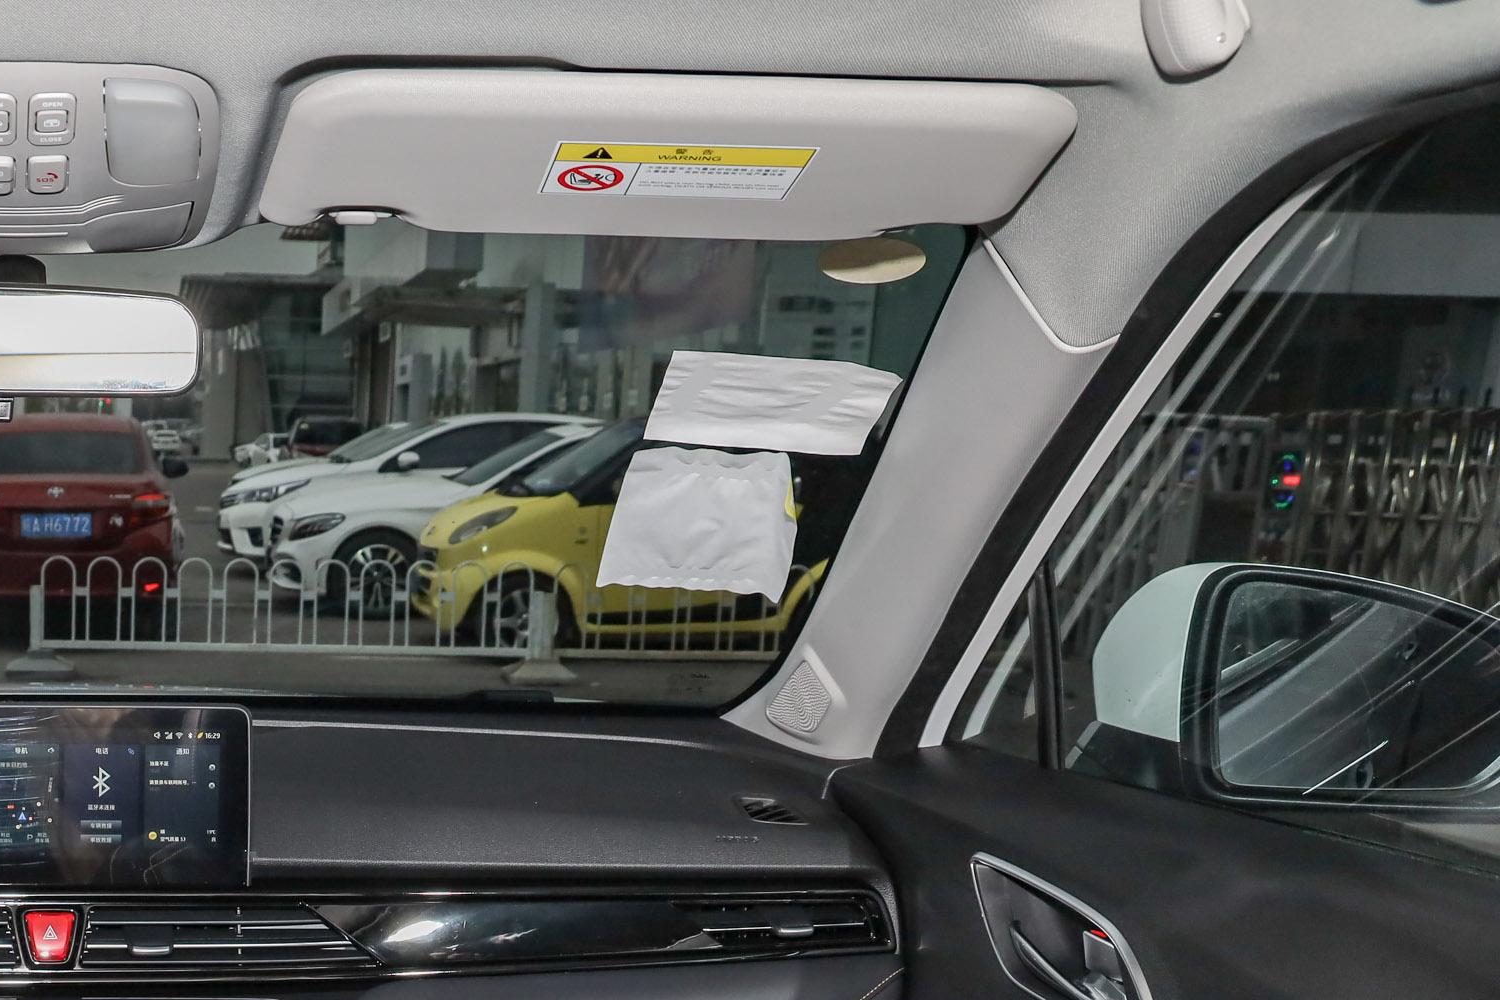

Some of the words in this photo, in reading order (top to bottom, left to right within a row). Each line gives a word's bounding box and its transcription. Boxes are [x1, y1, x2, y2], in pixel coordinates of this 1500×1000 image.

[658, 154, 722, 162] WARNING
[95, 747, 109, 755] 电话
[175, 747, 190, 755] 通知
